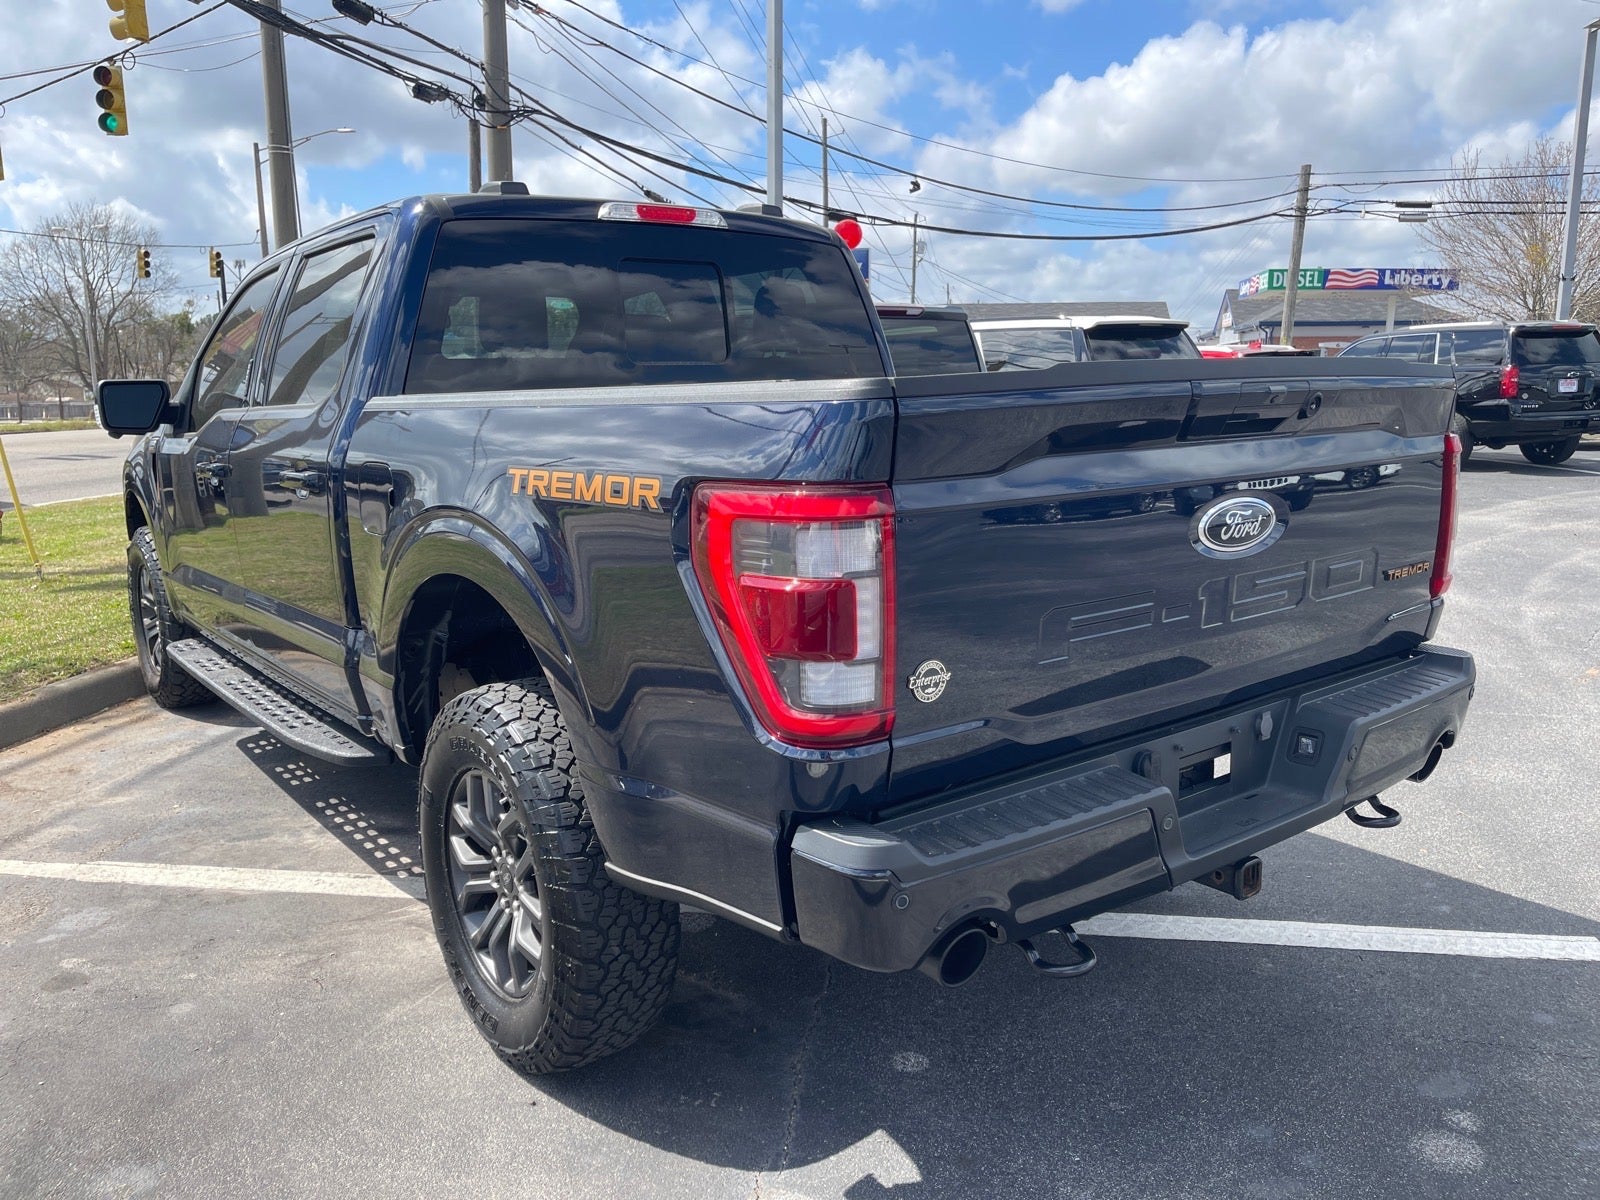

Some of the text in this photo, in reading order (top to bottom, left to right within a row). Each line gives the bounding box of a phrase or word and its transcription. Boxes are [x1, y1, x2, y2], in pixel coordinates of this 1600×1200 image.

[1272, 271, 1322, 288] DISEL
[1383, 269, 1451, 290] Liberty
[507, 466, 664, 513] TREMOR
[1220, 509, 1267, 540] Ford
[1386, 561, 1430, 580] TREMOR
[1038, 549, 1378, 665] F-150
[909, 671, 951, 689] Enterprise
